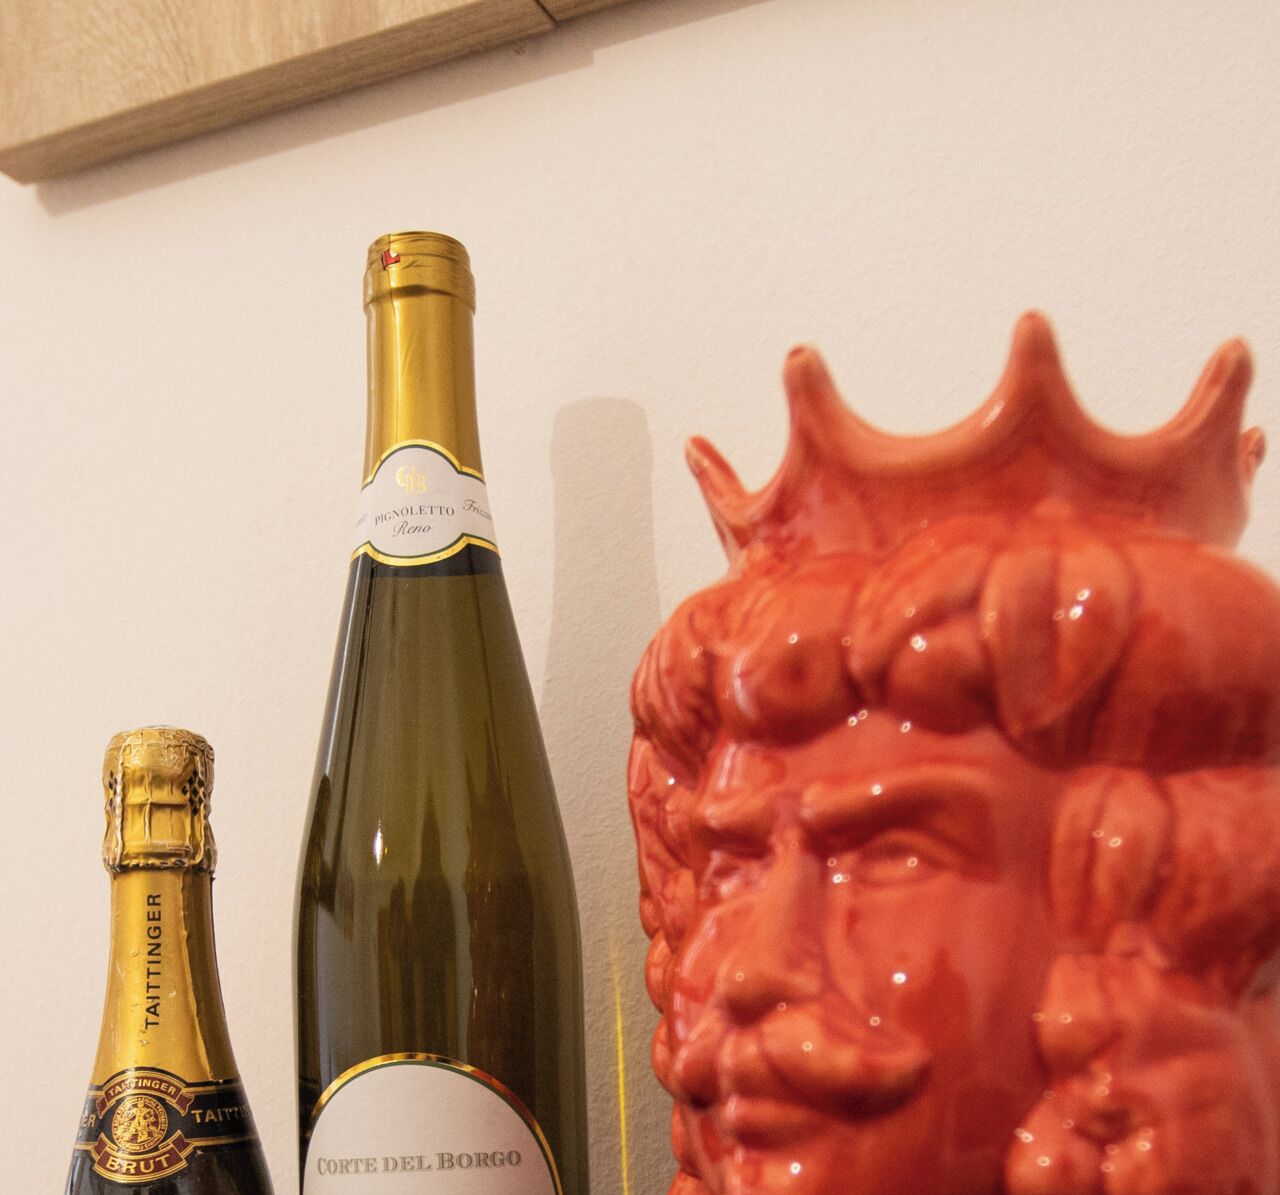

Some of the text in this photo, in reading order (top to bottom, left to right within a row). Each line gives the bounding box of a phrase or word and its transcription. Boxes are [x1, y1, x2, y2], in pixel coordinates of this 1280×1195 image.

[375, 505, 455, 525] PIGNOLETTO
[392, 520, 432, 537] Reno
[145, 894, 162, 1030] TAITTINGER
[108, 1077, 177, 1096] TAITTINGER
[106, 1153, 170, 1175] BRUT
[317, 1150, 522, 1176] CORTE DEL BORGO
